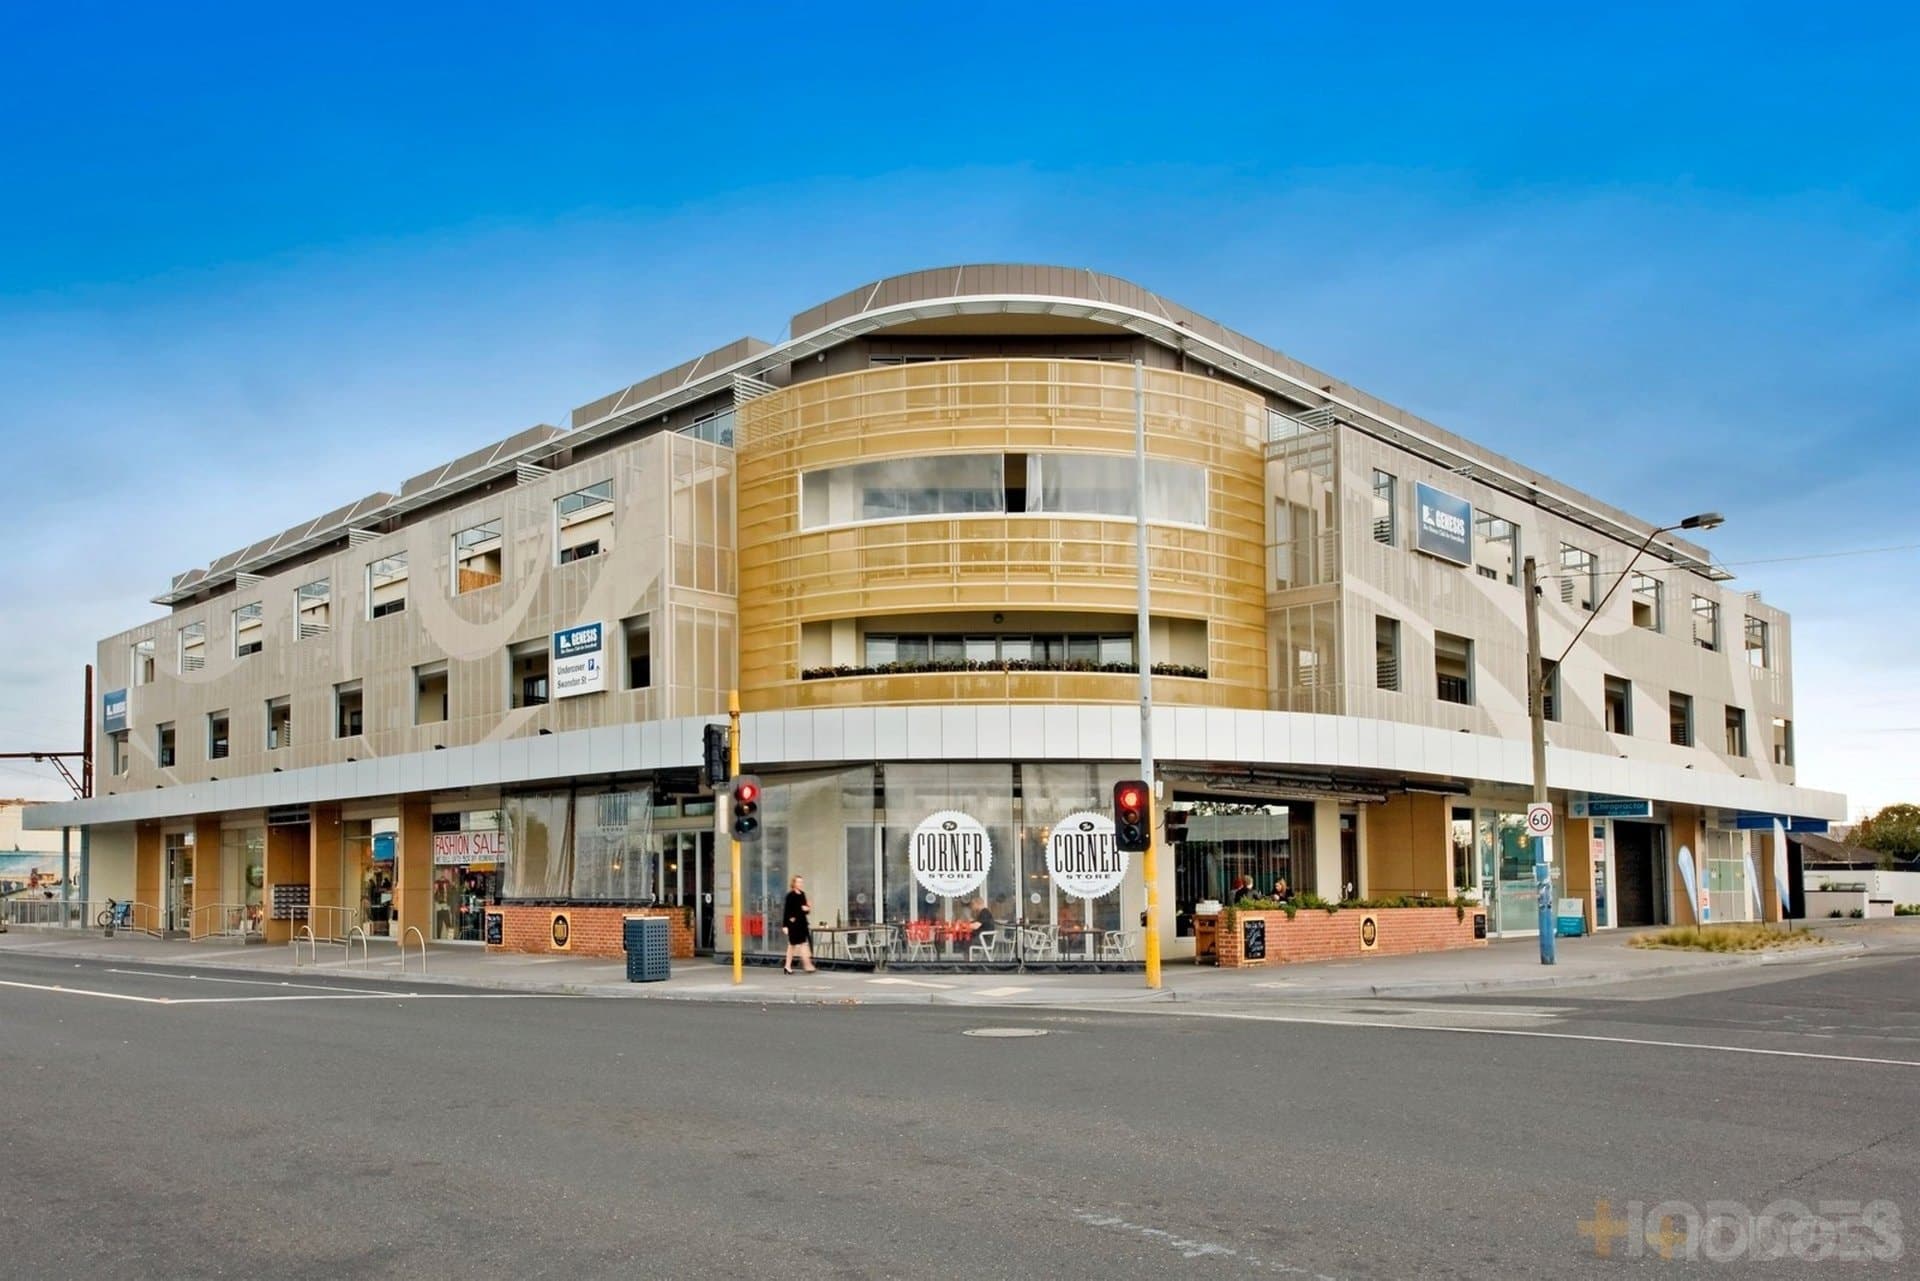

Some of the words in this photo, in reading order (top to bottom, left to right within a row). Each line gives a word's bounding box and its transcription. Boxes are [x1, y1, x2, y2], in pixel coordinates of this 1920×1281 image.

[1435, 510, 1465, 537] GENESIS
[571, 628, 598, 646] GENESIS
[557, 663, 586, 676] Undercover
[1532, 813, 1549, 826] 60
[435, 834, 469, 855] FASHION
[473, 832, 505, 855] SALE
[917, 833, 983, 872] CORNER
[1054, 833, 1121, 873] CORNER
